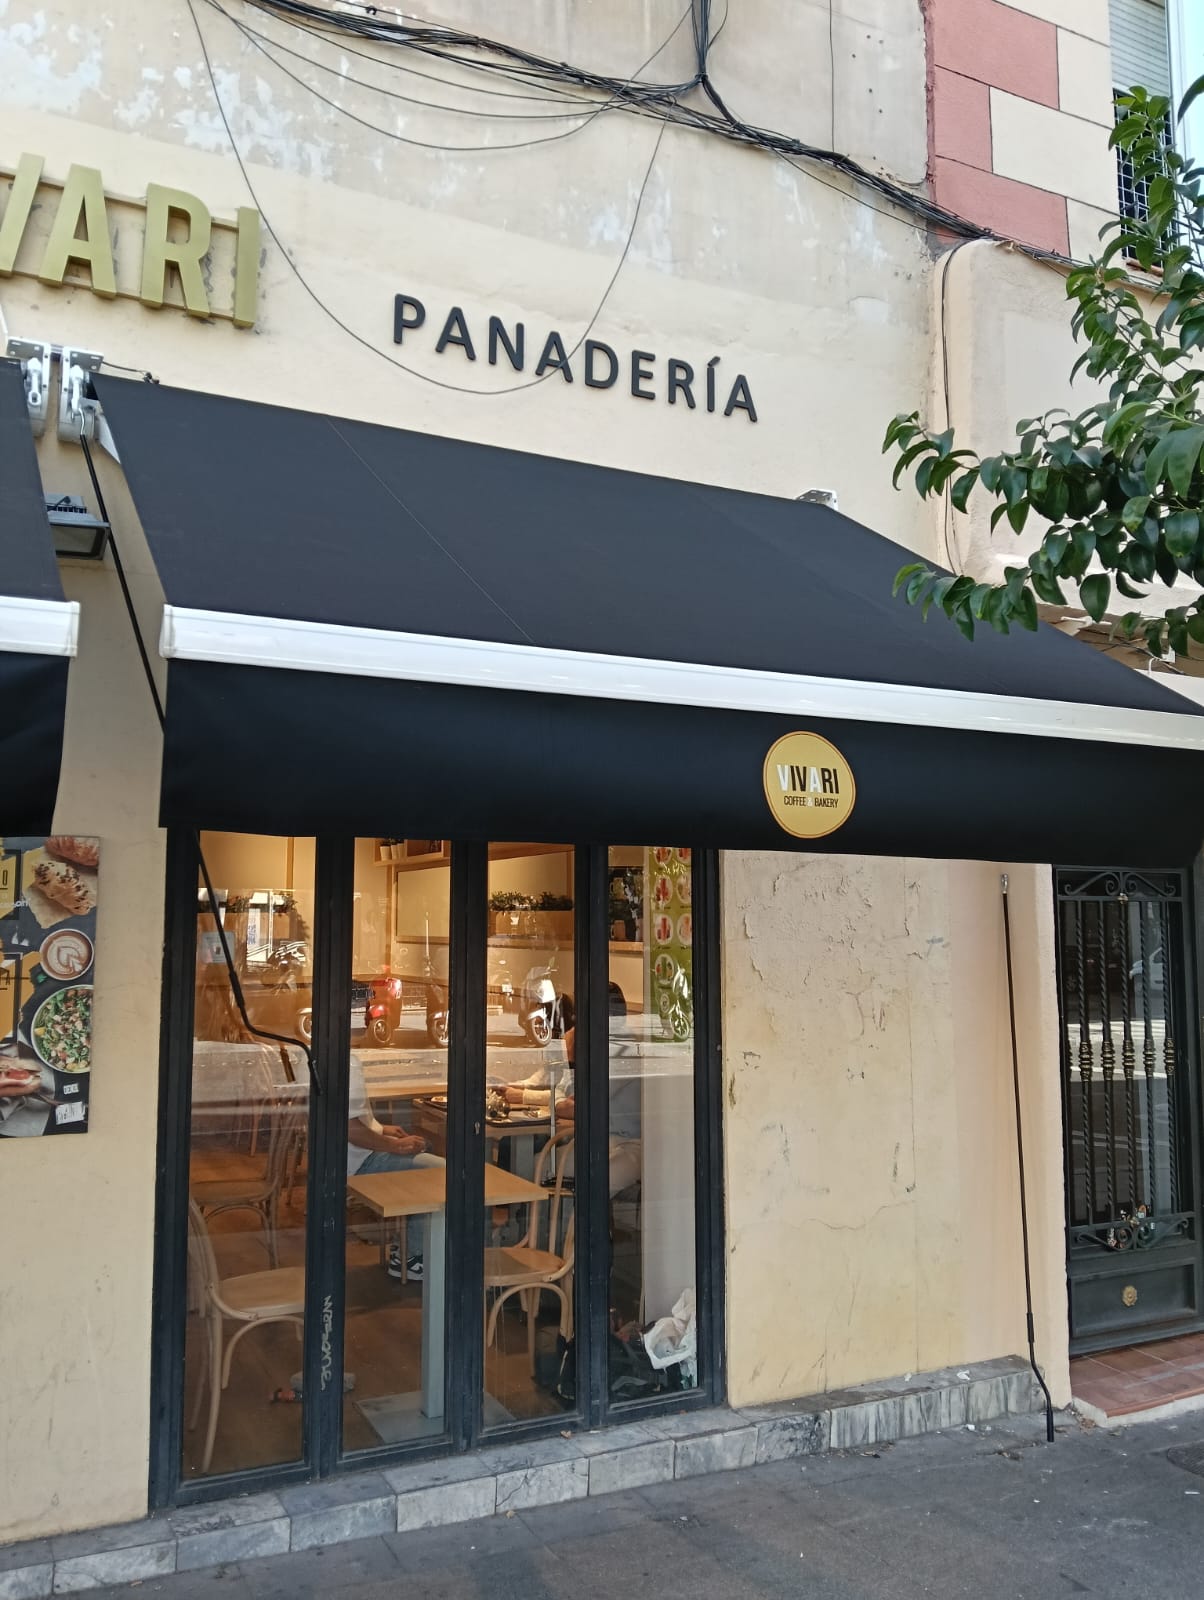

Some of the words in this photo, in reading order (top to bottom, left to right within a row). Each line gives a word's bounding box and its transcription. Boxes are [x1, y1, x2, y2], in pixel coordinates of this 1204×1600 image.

[393, 293, 758, 423] PANADERÍA
[776, 764, 840, 794] VIVARI
[783, 795, 807, 807] COFFEE
[814, 797, 839, 809] BAKERY
